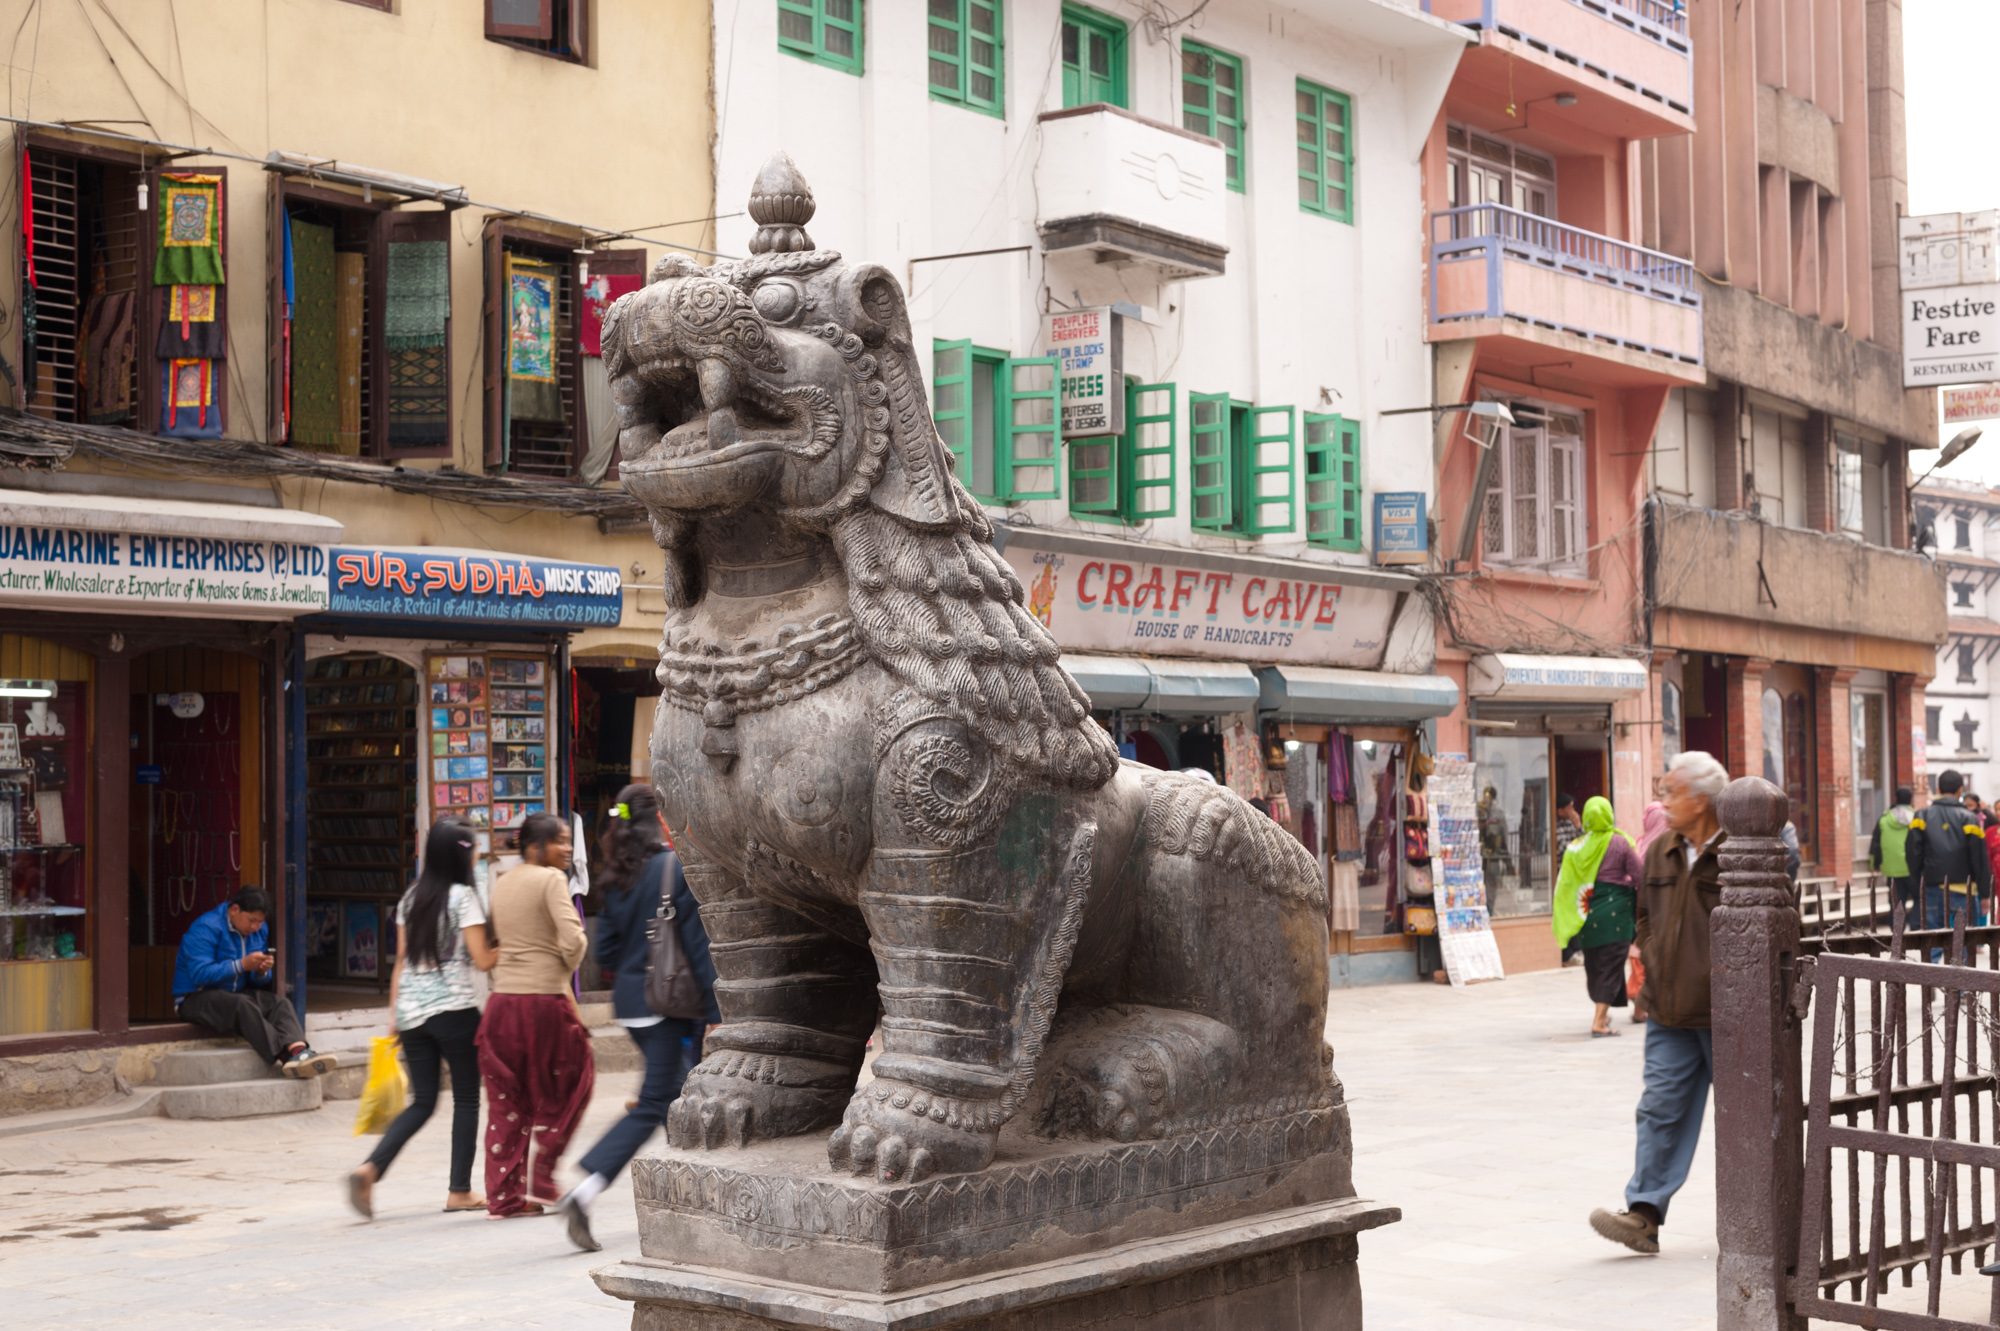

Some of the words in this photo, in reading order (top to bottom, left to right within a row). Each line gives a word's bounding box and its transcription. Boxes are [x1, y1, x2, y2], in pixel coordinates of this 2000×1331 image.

[1912, 297, 1996, 321] Festive
[1052, 313, 1099, 329] POLYPLATE
[1052, 326, 1099, 342] ENGRAVERS
[1926, 326, 1981, 348] Fare
[1074, 343, 1105, 357] BLOCKS
[1065, 356, 1093, 371] STAMP
[1913, 361, 1995, 376] RESTAURANT
[1061, 374, 1104, 400] PRESS
[1075, 416, 1107, 430] DESIGNS
[1387, 507, 1411, 517] VISA
[129, 534, 265, 573] ENTERPRISES
[44, 568, 114, 594] Wholesaler
[115, 578, 126, 595] &
[128, 574, 182, 600] Exporter
[183, 578, 195, 602] of
[196, 578, 240, 602] Nepalese
[242, 581, 268, 601] Gems
[270, 587, 278, 602] &
[543, 567, 587, 593] MUSIC
[586, 570, 621, 596] SHOP
[1077, 561, 1233, 618] CRAFT
[1242, 577, 1342, 628] CAVE
[331, 593, 392, 613] Wholesale
[392, 597, 402, 614] &
[403, 598, 440, 615] Retail
[455, 599, 474, 617] All
[474, 600, 510, 618] Kinds
[511, 602, 522, 620] of
[522, 602, 553, 620] Music
[1134, 621, 1179, 639] HOUSE
[1183, 625, 1199, 640] OF
[1204, 626, 1294, 647] HANDICRAFTS
